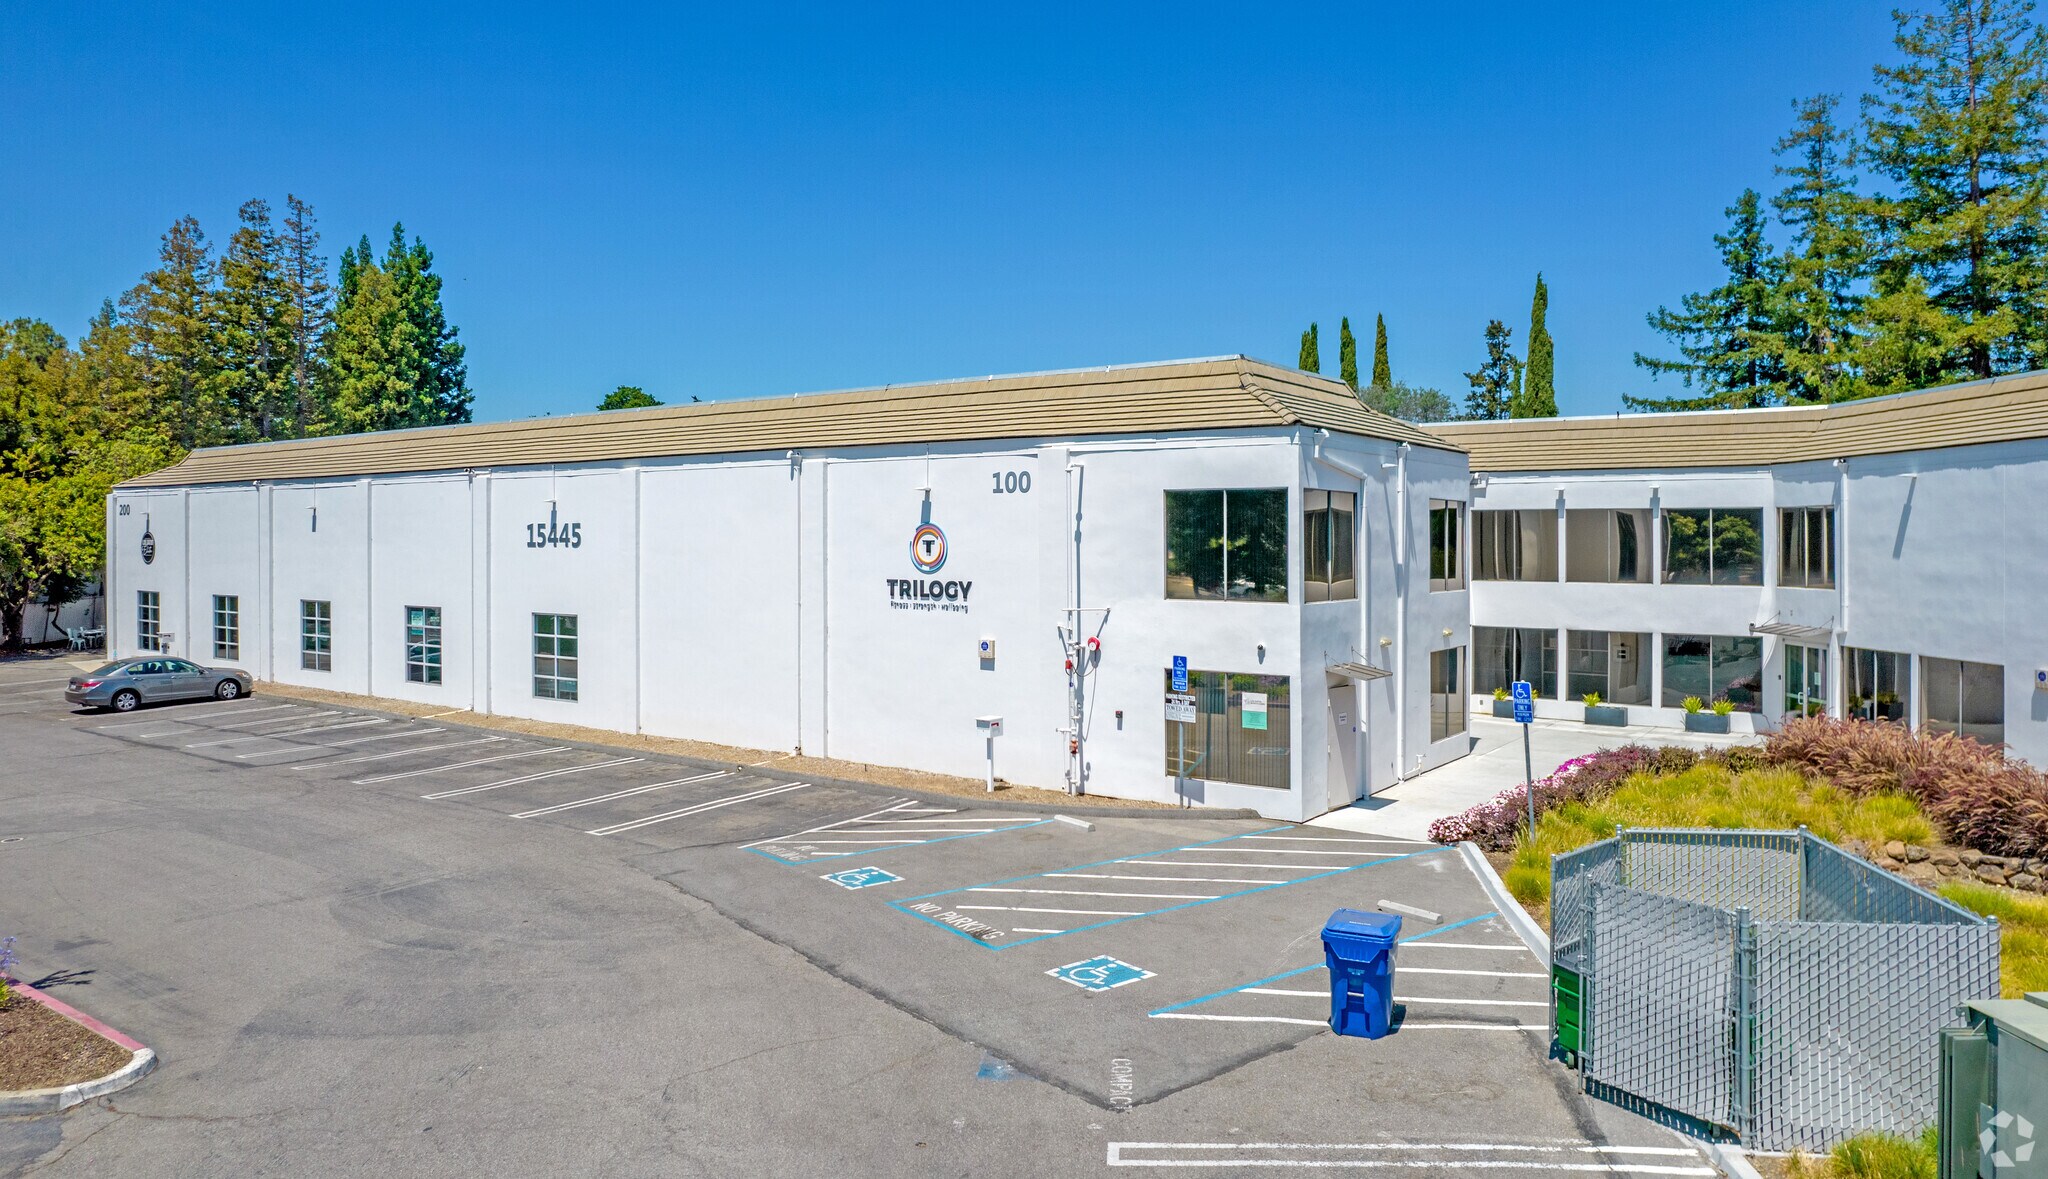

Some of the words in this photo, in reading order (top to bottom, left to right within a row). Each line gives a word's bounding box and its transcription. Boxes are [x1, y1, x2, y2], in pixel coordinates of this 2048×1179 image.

[992, 470, 1031, 493] 100
[119, 504, 130, 516] 200
[527, 522, 581, 548] 15445
[922, 540, 935, 555] T
[886, 579, 972, 600] TRILOGY
[1166, 704, 1183, 712] TOWED
[909, 902, 942, 913] NO
[933, 911, 1005, 940] PARKING
